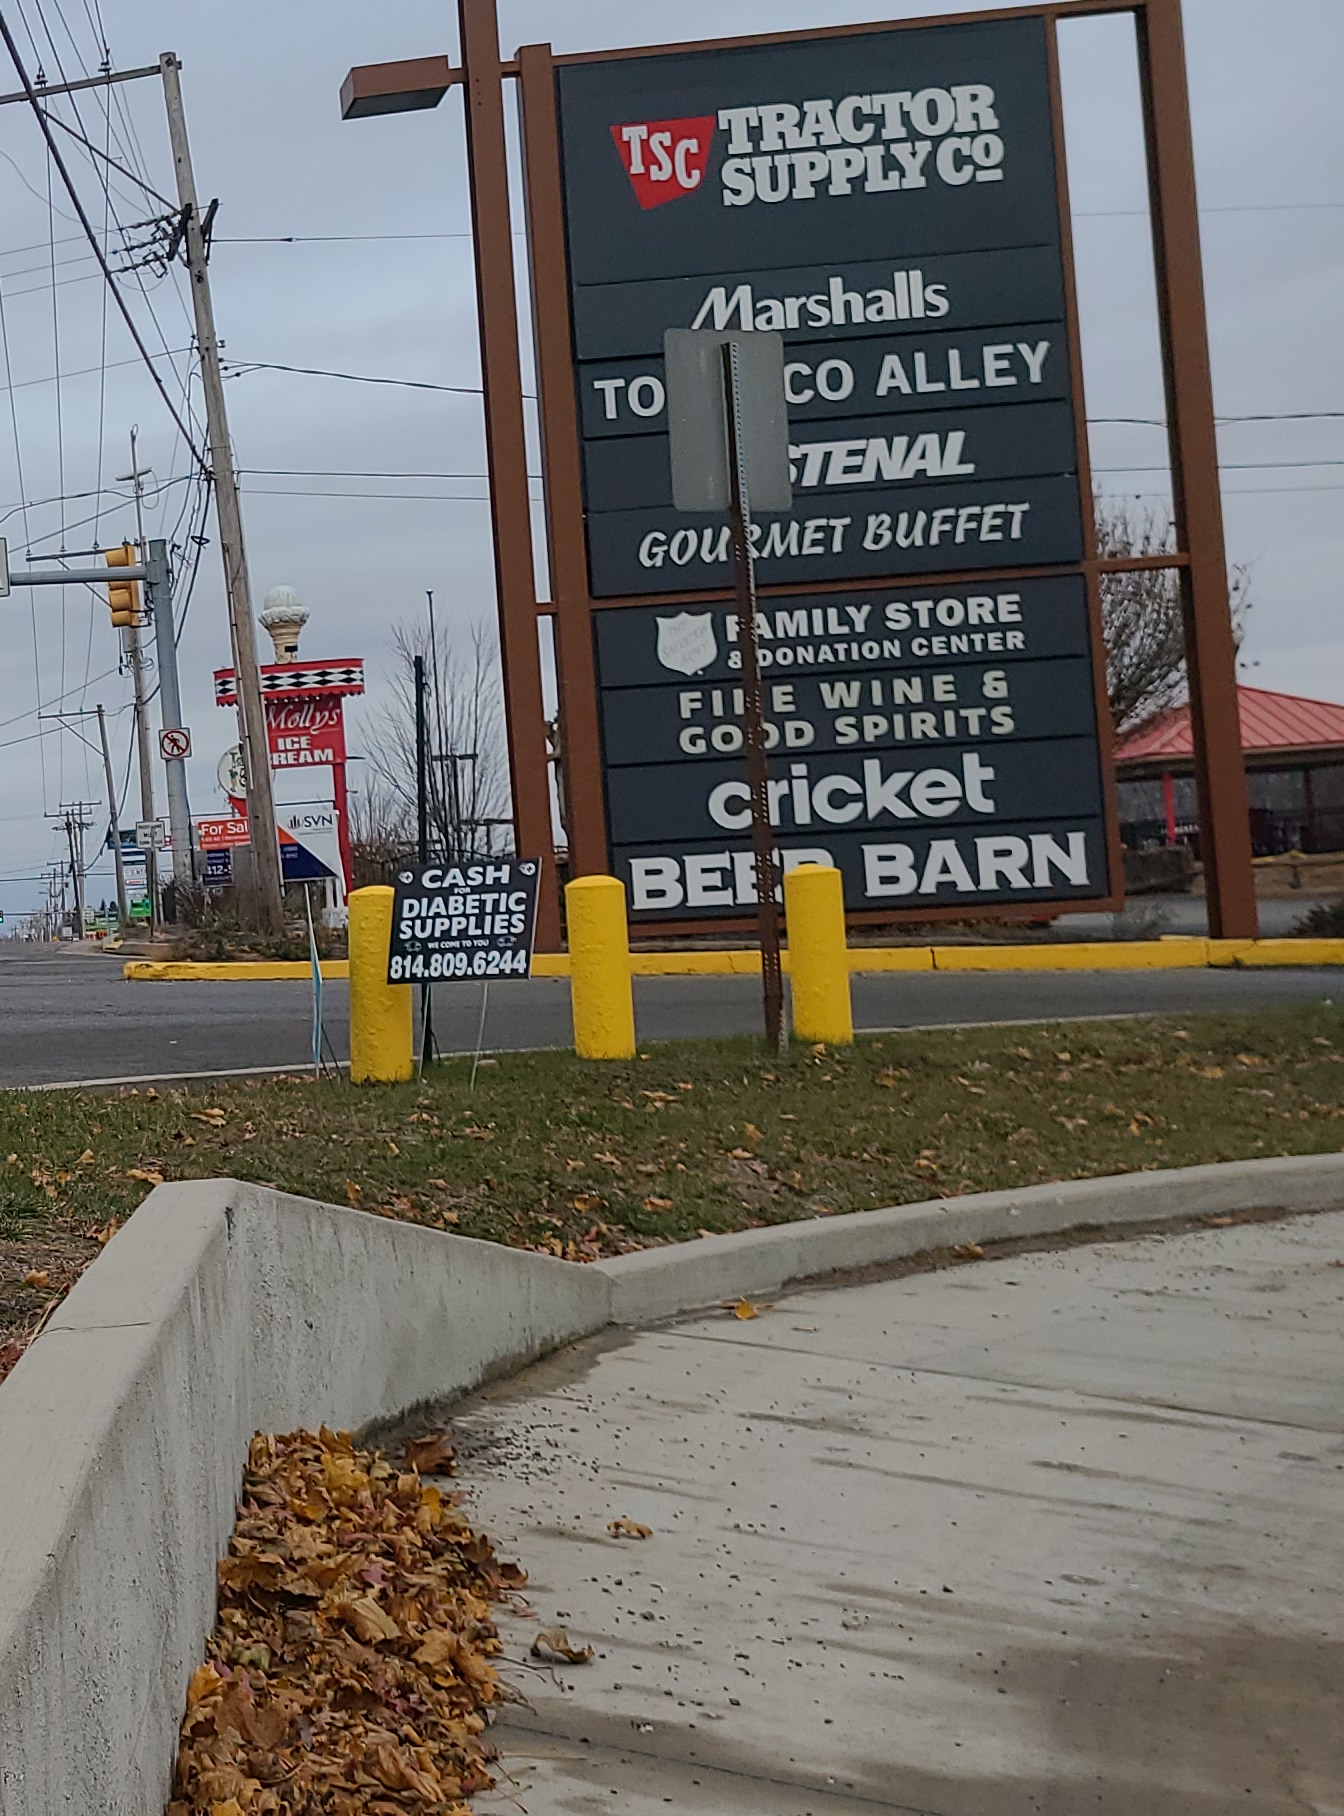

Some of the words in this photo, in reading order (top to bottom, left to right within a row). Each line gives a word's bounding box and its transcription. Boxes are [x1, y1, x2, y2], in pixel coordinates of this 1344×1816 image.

[718, 84, 1000, 156] TRACTOR
[620, 122, 702, 190] TSC
[721, 140, 934, 207] SUPPLY
[692, 269, 950, 332] Marshalls
[594, 358, 854, 421] TOCO
[875, 341, 1051, 397] ALLEY
[637, 516, 852, 568] GOURMET
[862, 503, 1031, 552] BUFFET
[724, 603, 874, 643] FAMILY
[882, 594, 1023, 632] STORE
[727, 650, 743, 670] &
[755, 638, 903, 668] DONATION
[911, 630, 1026, 656] CENTER
[818, 672, 958, 712] WINE
[982, 669, 1010, 700] &
[267, 701, 340, 734] Molly's
[834, 705, 1015, 748] SPIRITS
[270, 748, 333, 765] REAM
[277, 736, 310, 750] ICE
[707, 751, 996, 831] cricket
[201, 822, 224, 837] For
[226, 819, 249, 835] Sal
[304, 813, 333, 829] SVN
[421, 865, 510, 888] CASH
[862, 832, 1090, 898] BARN
[403, 892, 527, 918] DIABETIC
[454, 887, 471, 895] FOR
[399, 914, 525, 940] SUPPLIES
[427, 941, 439, 950] WE
[461, 939, 472, 948] TO
[473, 938, 490, 948] YOU
[390, 949, 527, 979] 814.809.6244
